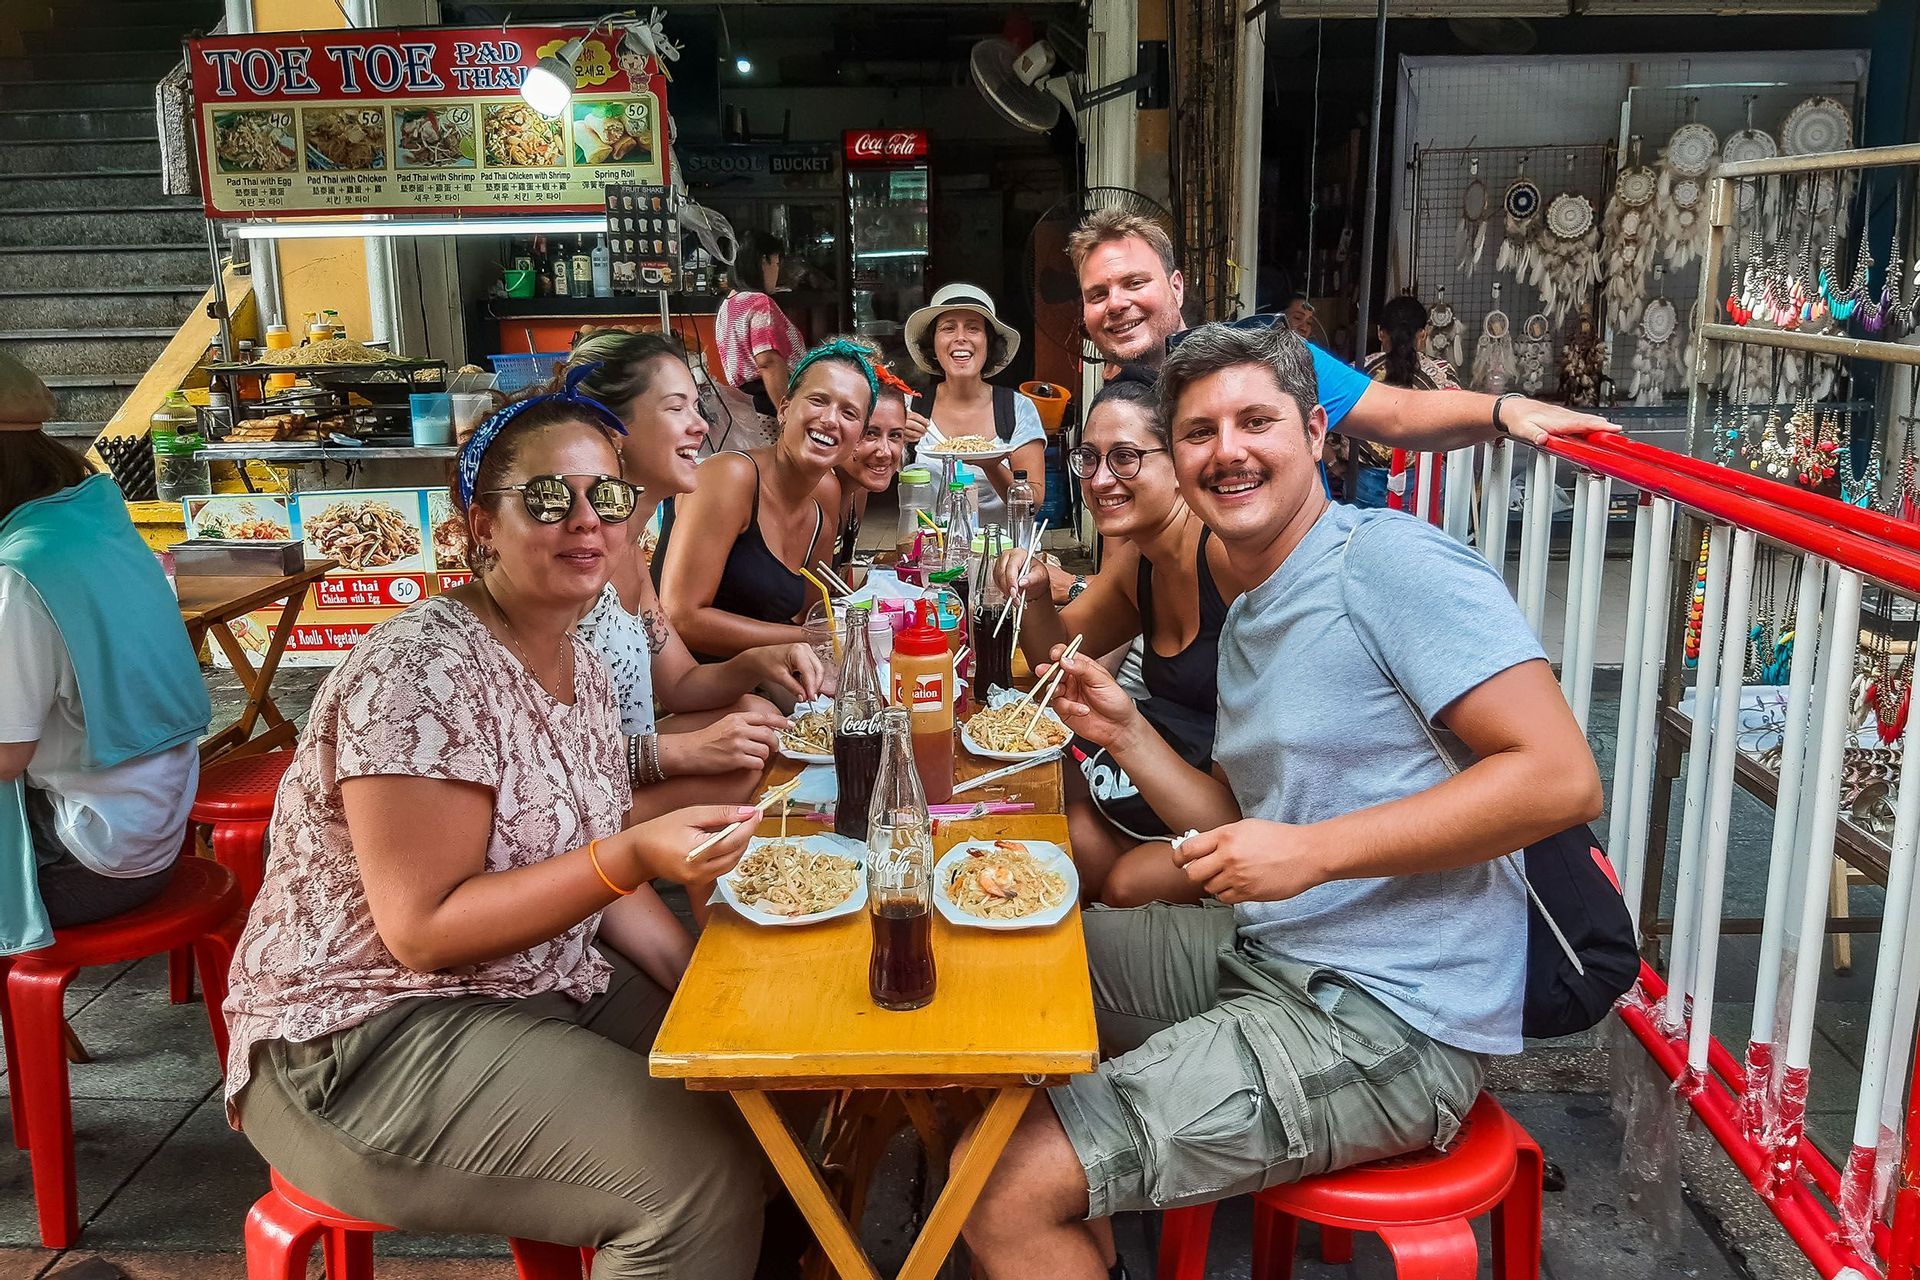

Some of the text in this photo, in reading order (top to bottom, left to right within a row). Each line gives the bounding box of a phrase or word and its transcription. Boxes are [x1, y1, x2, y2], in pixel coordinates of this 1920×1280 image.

[454, 40, 522, 65] PAD
[202, 43, 445, 96] TOE TOE
[451, 109, 469, 123] 60
[628, 105, 644, 117] 50
[270, 113, 291, 127] 40
[362, 112, 381, 125] 50
[772, 157, 829, 171] BUCKET
[307, 174, 387, 184] Pad Thai with Chicken
[396, 172, 475, 182] Pad Thai with Shrimp
[480, 171, 571, 181] Pad Thai Chicken with Shrimp
[594, 169, 635, 180] Spring Roll
[226, 177, 292, 187] Pad Thai with Egg
[320, 579, 379, 593] Pad thai
[443, 576, 464, 589] Pad
[397, 583, 413, 597] 50
[321, 593, 381, 605] Chicken with Egg
[297, 629, 323, 645] Roolls
